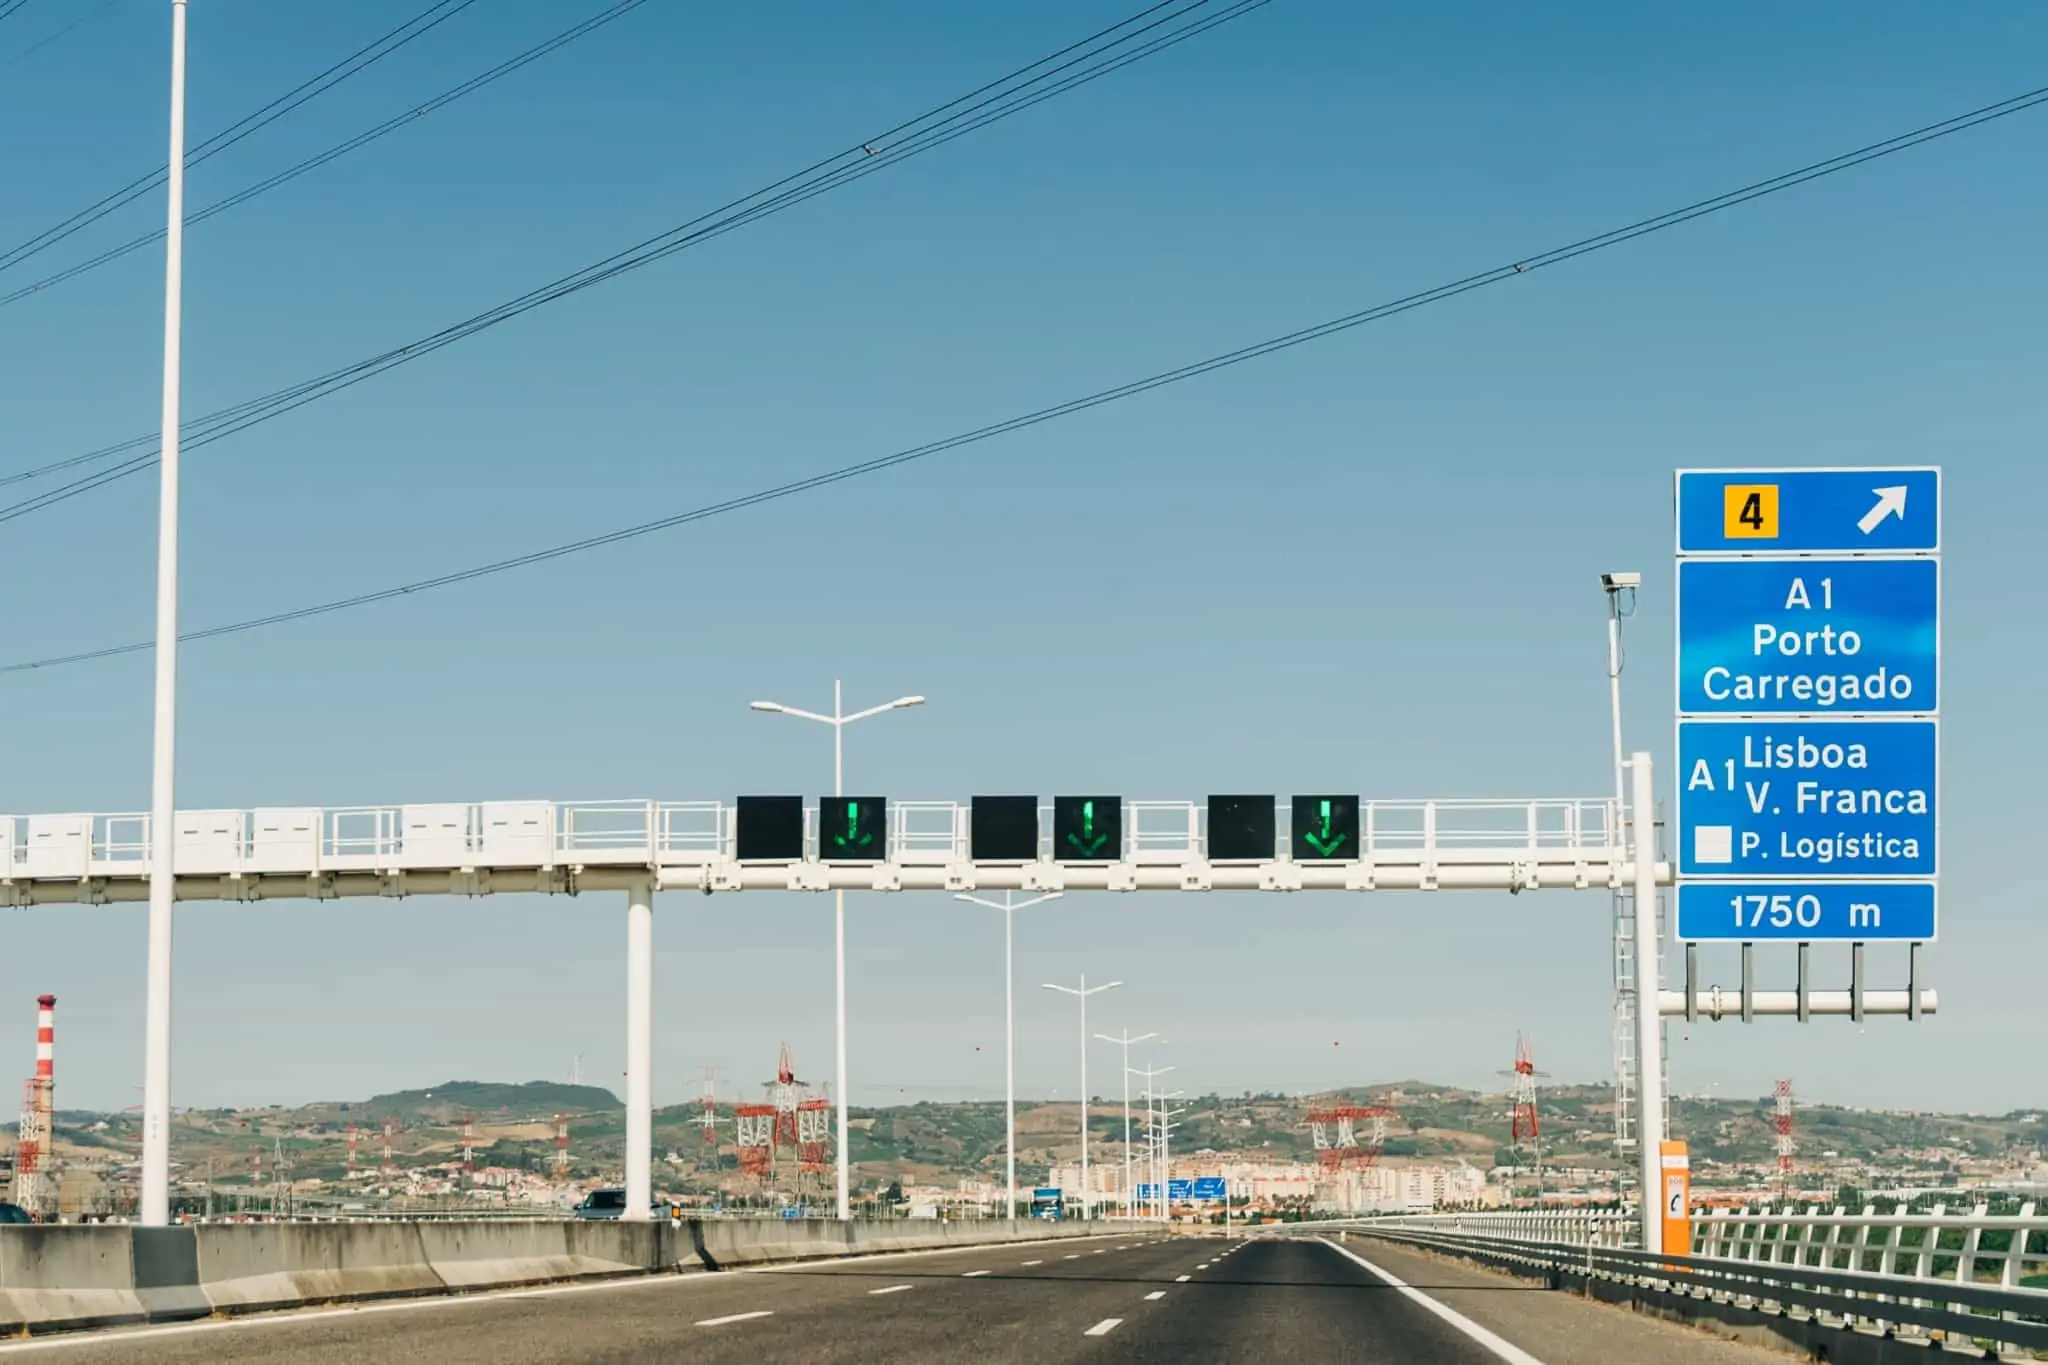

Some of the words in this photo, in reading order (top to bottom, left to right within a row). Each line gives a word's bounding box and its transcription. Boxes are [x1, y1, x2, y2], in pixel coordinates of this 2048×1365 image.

[1739, 493, 1764, 530] 4
[1754, 624, 1861, 656] Porto
[1703, 667, 1912, 706] Carregado
[1744, 735, 1868, 769] Lisboa
[1745, 781, 1780, 814] V.
[1797, 781, 1927, 814] Franca
[1741, 831, 1768, 858] P.
[1781, 831, 1919, 863] Logística
[1730, 895, 1821, 928] 1750
[1849, 903, 1881, 927] m
